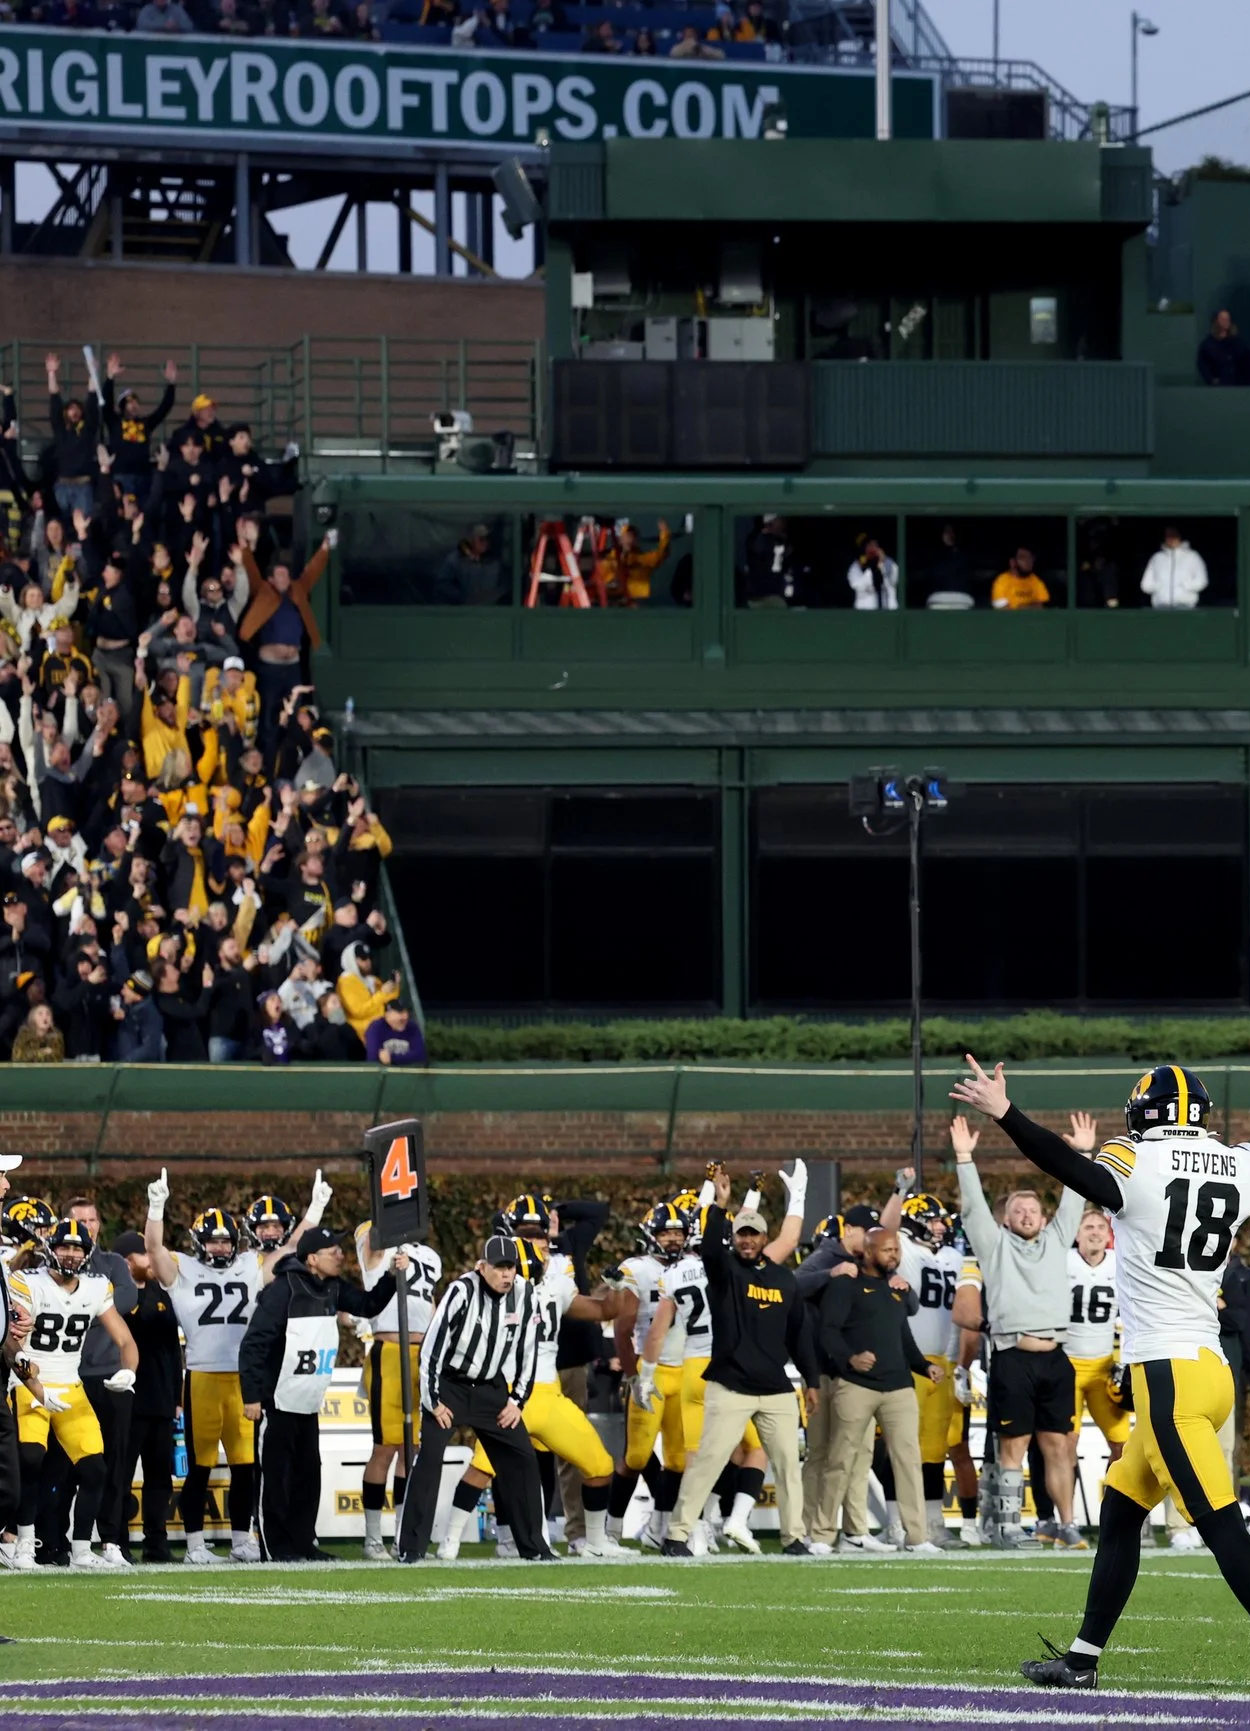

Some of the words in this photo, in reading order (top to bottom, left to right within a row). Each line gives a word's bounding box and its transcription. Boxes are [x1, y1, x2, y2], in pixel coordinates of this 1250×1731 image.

[1162, 1129, 1199, 1137] TOGETHER
[381, 1136, 418, 1200] 4
[1172, 1150, 1237, 1178] STEVENS
[1154, 1177, 1240, 1272] 18
[194, 1281, 250, 1326] 22
[674, 1285, 709, 1336] 2
[747, 1283, 784, 1304] IOWA
[1070, 1284, 1115, 1324] 16
[29, 1312, 91, 1353] 89
